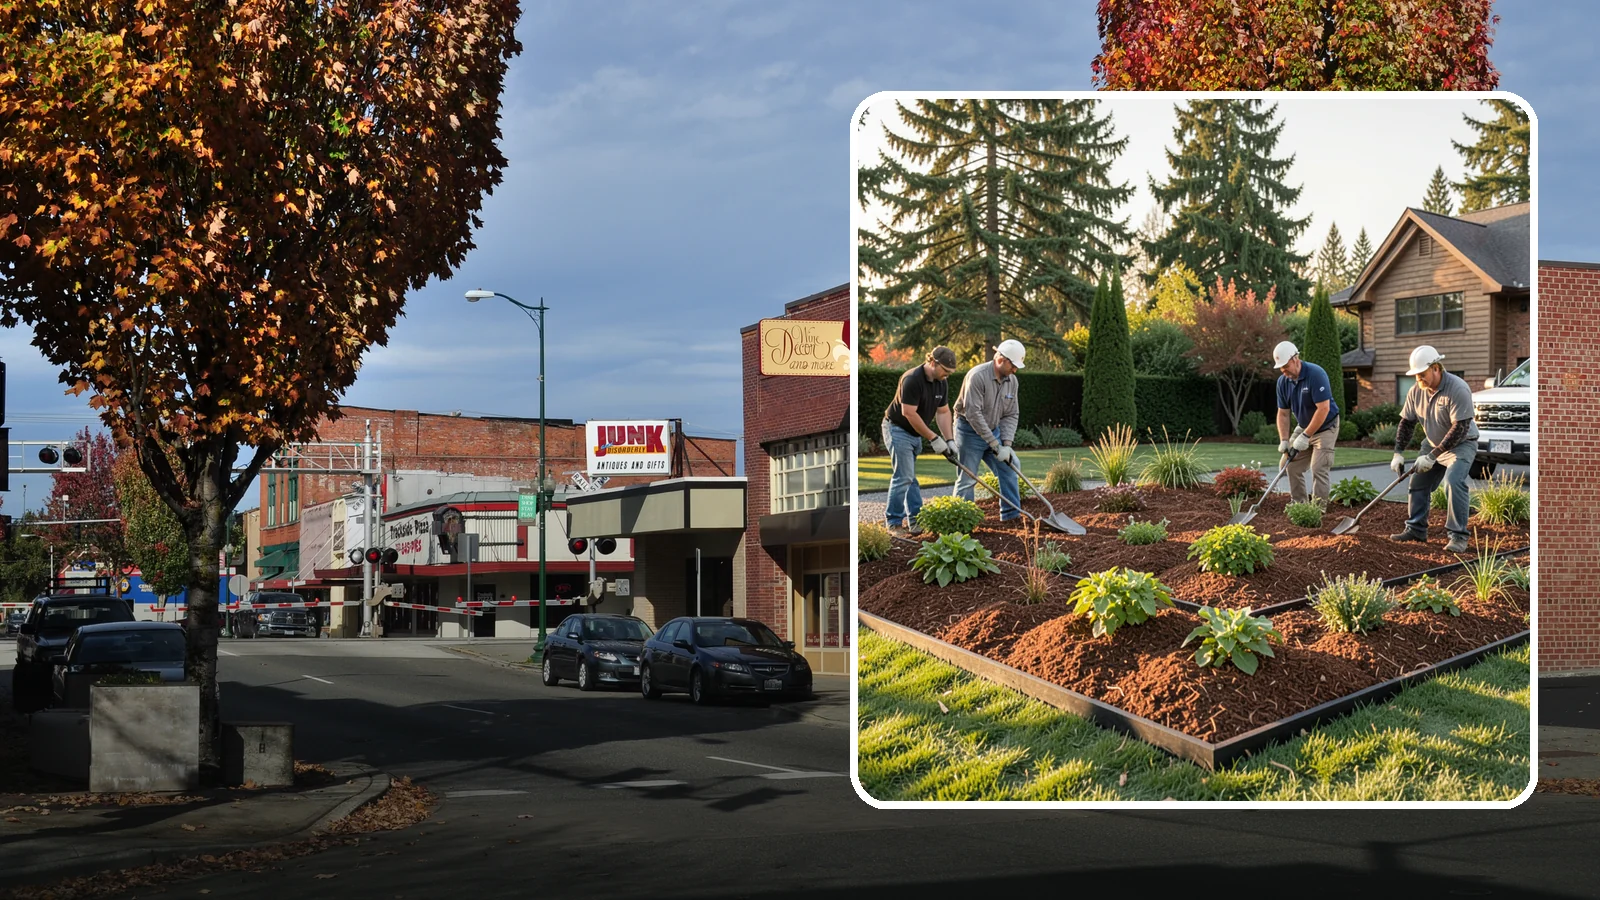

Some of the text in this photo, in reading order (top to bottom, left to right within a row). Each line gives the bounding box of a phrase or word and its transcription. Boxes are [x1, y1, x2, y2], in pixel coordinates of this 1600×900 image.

[595, 425, 664, 457] JUNK
[607, 446, 646, 454] DISORDERLY
[597, 460, 665, 470] ANTIQUES AND GIFTS
[414, 519, 429, 535] Pizza
